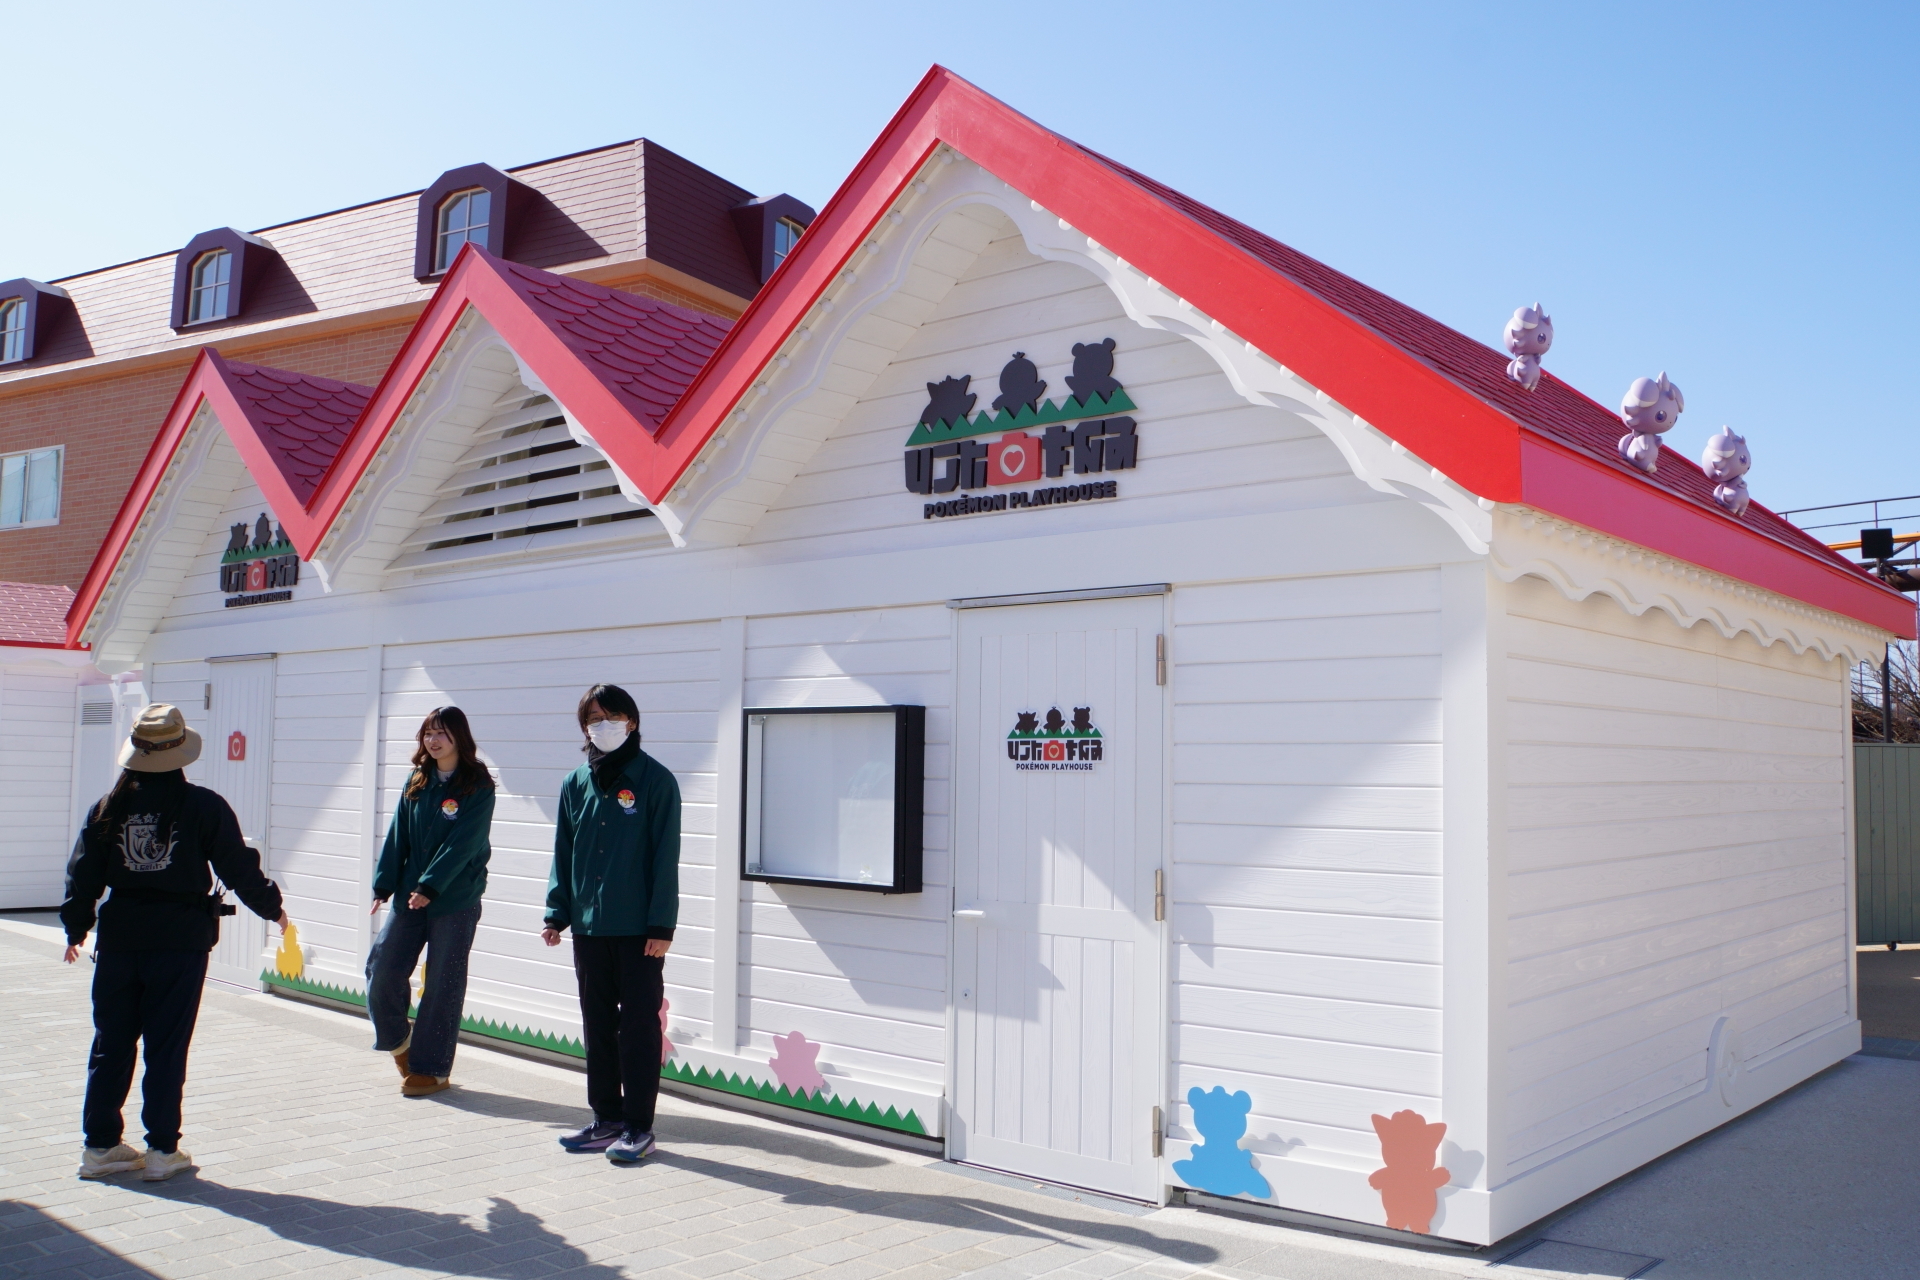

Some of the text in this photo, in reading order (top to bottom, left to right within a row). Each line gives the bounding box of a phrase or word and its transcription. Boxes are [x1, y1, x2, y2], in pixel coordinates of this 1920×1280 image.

[923, 480, 1117, 519] POKÉMON PLAYHOUSE
[1016, 762, 1093, 771] POKÉMON PLAYHOUSE
